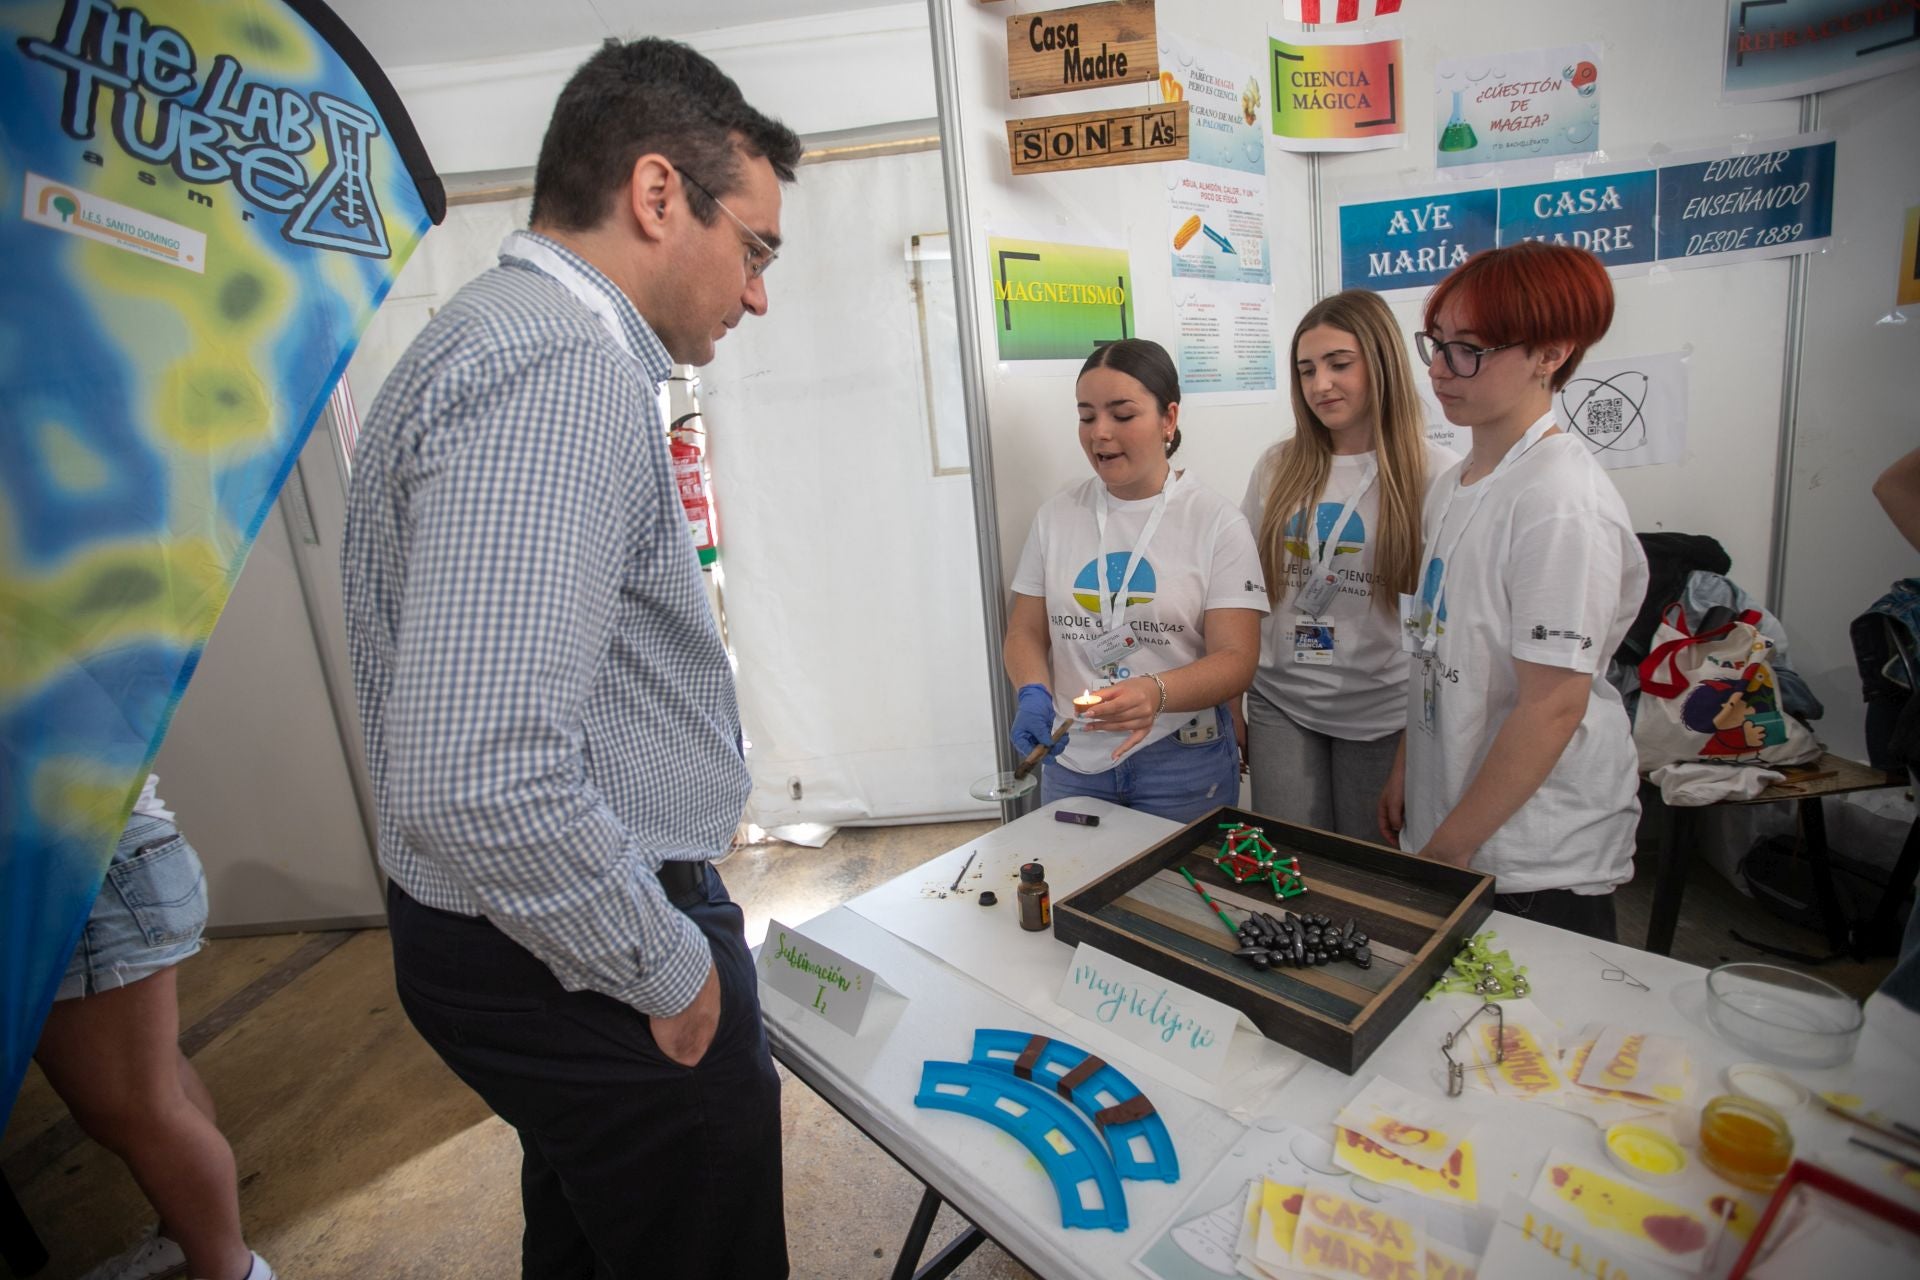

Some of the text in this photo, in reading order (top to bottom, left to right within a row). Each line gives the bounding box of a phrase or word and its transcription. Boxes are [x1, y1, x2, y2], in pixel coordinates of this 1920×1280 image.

[1029, 16, 1079, 53] Casa
[1063, 43, 1128, 84] Madre
[1188, 81, 1238, 102] PERO ES CIENCIA
[1190, 70, 1234, 90] PARECE MAGIA
[1291, 71, 1370, 88] CIENCIA
[198, 54, 316, 156] LAB
[1195, 106, 1218, 119] GRANO
[1218, 111, 1227, 121] DE
[1292, 89, 1372, 110] MÁGICA
[1510, 99, 1531, 113] DE
[1201, 118, 1234, 134] PALOMITA
[1490, 114, 1550, 132] MAGIA?
[1703, 150, 1790, 182] EDUCAR
[1534, 186, 1622, 218] CASA
[1682, 182, 1811, 220] ENSEÑANDO
[82, 210, 103, 225] I.E.S.
[106, 217, 136, 236] SANTO
[137, 228, 181, 250] DOMINGO
[1387, 202, 1453, 236] AVE
[1522, 225, 1634, 253] ADRE
[1685, 223, 1803, 257] DESDE 1889
[1368, 239, 1470, 278] MARÍA
[995, 279, 1125, 306] MAGNETISMO
[1130, 620, 1186, 633] CIENCIAS
[1309, 1193, 1404, 1250] CASA
